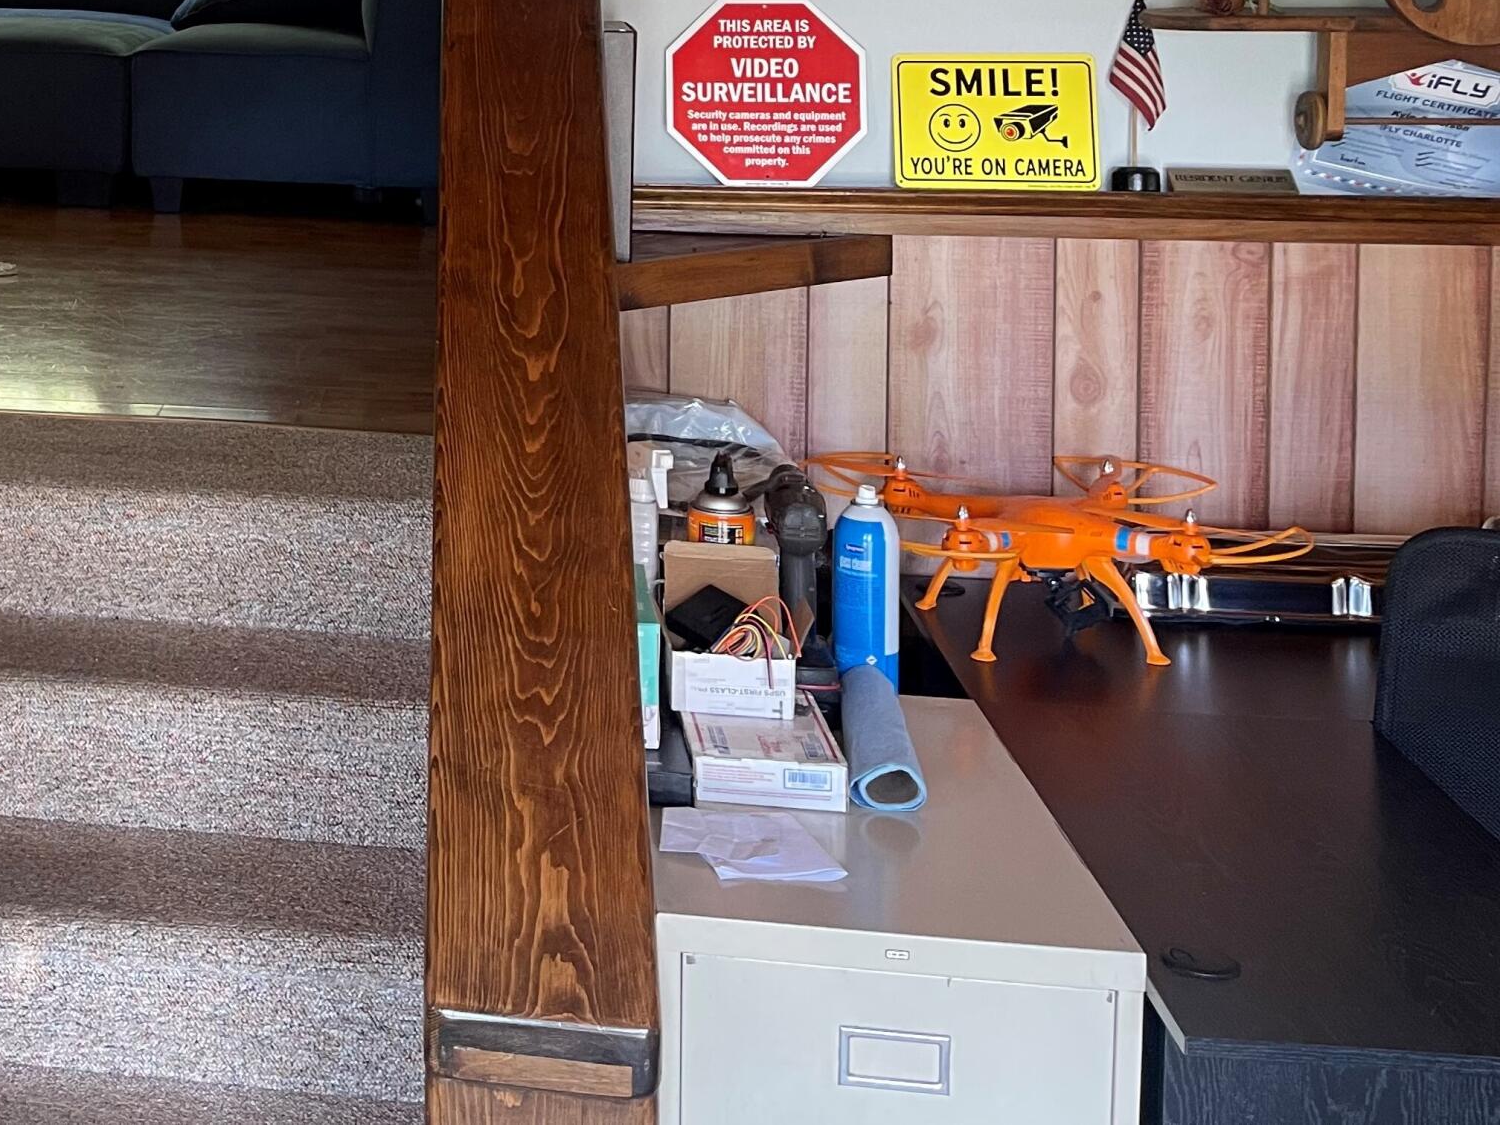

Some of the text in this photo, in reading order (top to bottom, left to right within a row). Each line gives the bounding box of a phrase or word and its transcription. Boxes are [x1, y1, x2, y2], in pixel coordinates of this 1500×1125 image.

[718, 19, 810, 33] THIS AREA IS
[713, 35, 816, 49] PROTECTED BY
[730, 57, 799, 78] VIDEO
[929, 67, 1059, 97] SMILE!
[1426, 74, 1493, 99] iFLY
[681, 82, 852, 104] SURVEILLANCE
[1375, 89, 1499, 119] FLIGHT CERTIFICATE
[687, 109, 846, 122] Security cameras and equipment
[691, 121, 842, 134] are in use. Recordings are used
[698, 133, 836, 145] to help prosecute any crimes
[1402, 128, 1463, 148] CHARLOTTE
[723, 145, 811, 155] committed on this
[745, 157, 789, 168] property.
[910, 155, 1087, 177] YOU'RE ON CAMERA
